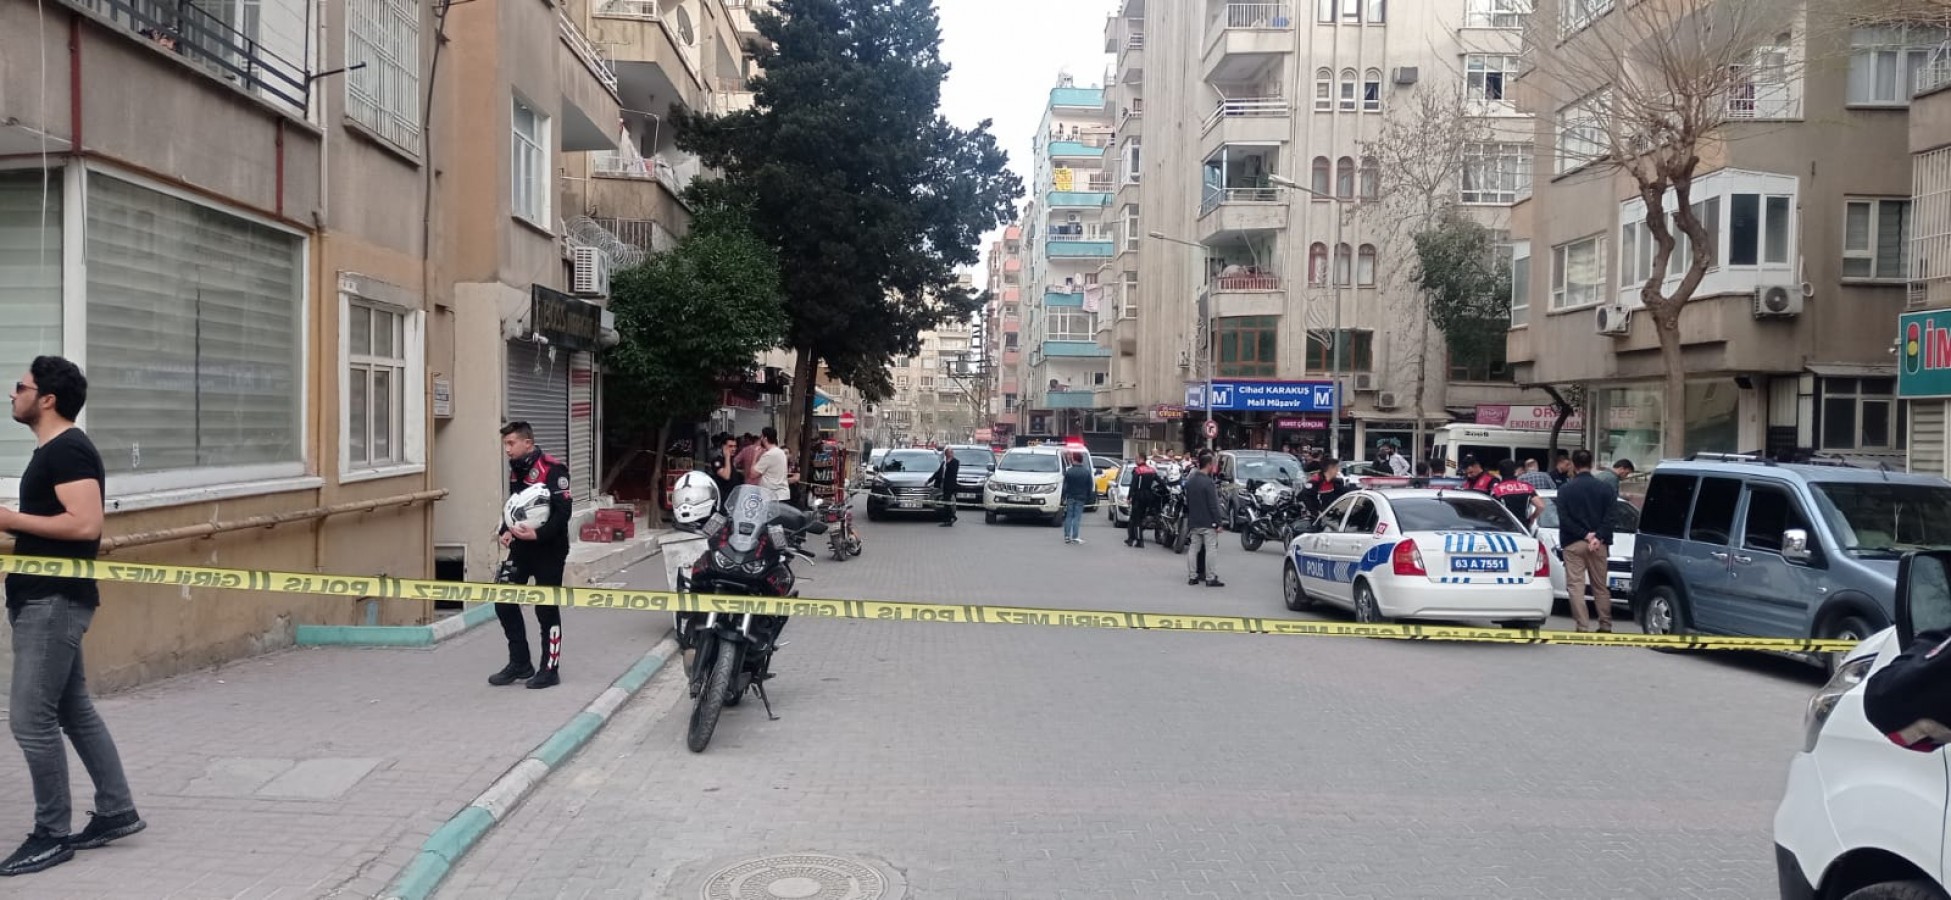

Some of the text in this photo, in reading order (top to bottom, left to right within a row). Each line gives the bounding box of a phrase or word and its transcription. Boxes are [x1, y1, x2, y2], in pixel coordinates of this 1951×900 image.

[1239, 386, 1309, 395] Cihad KARAKUŞ
[1247, 398, 1301, 408] Mali Müşavir
[1510, 420, 1541, 429] EKMEK
[1306, 558, 1324, 578] POLİS
[1455, 560, 1505, 568] 63 A 7551
